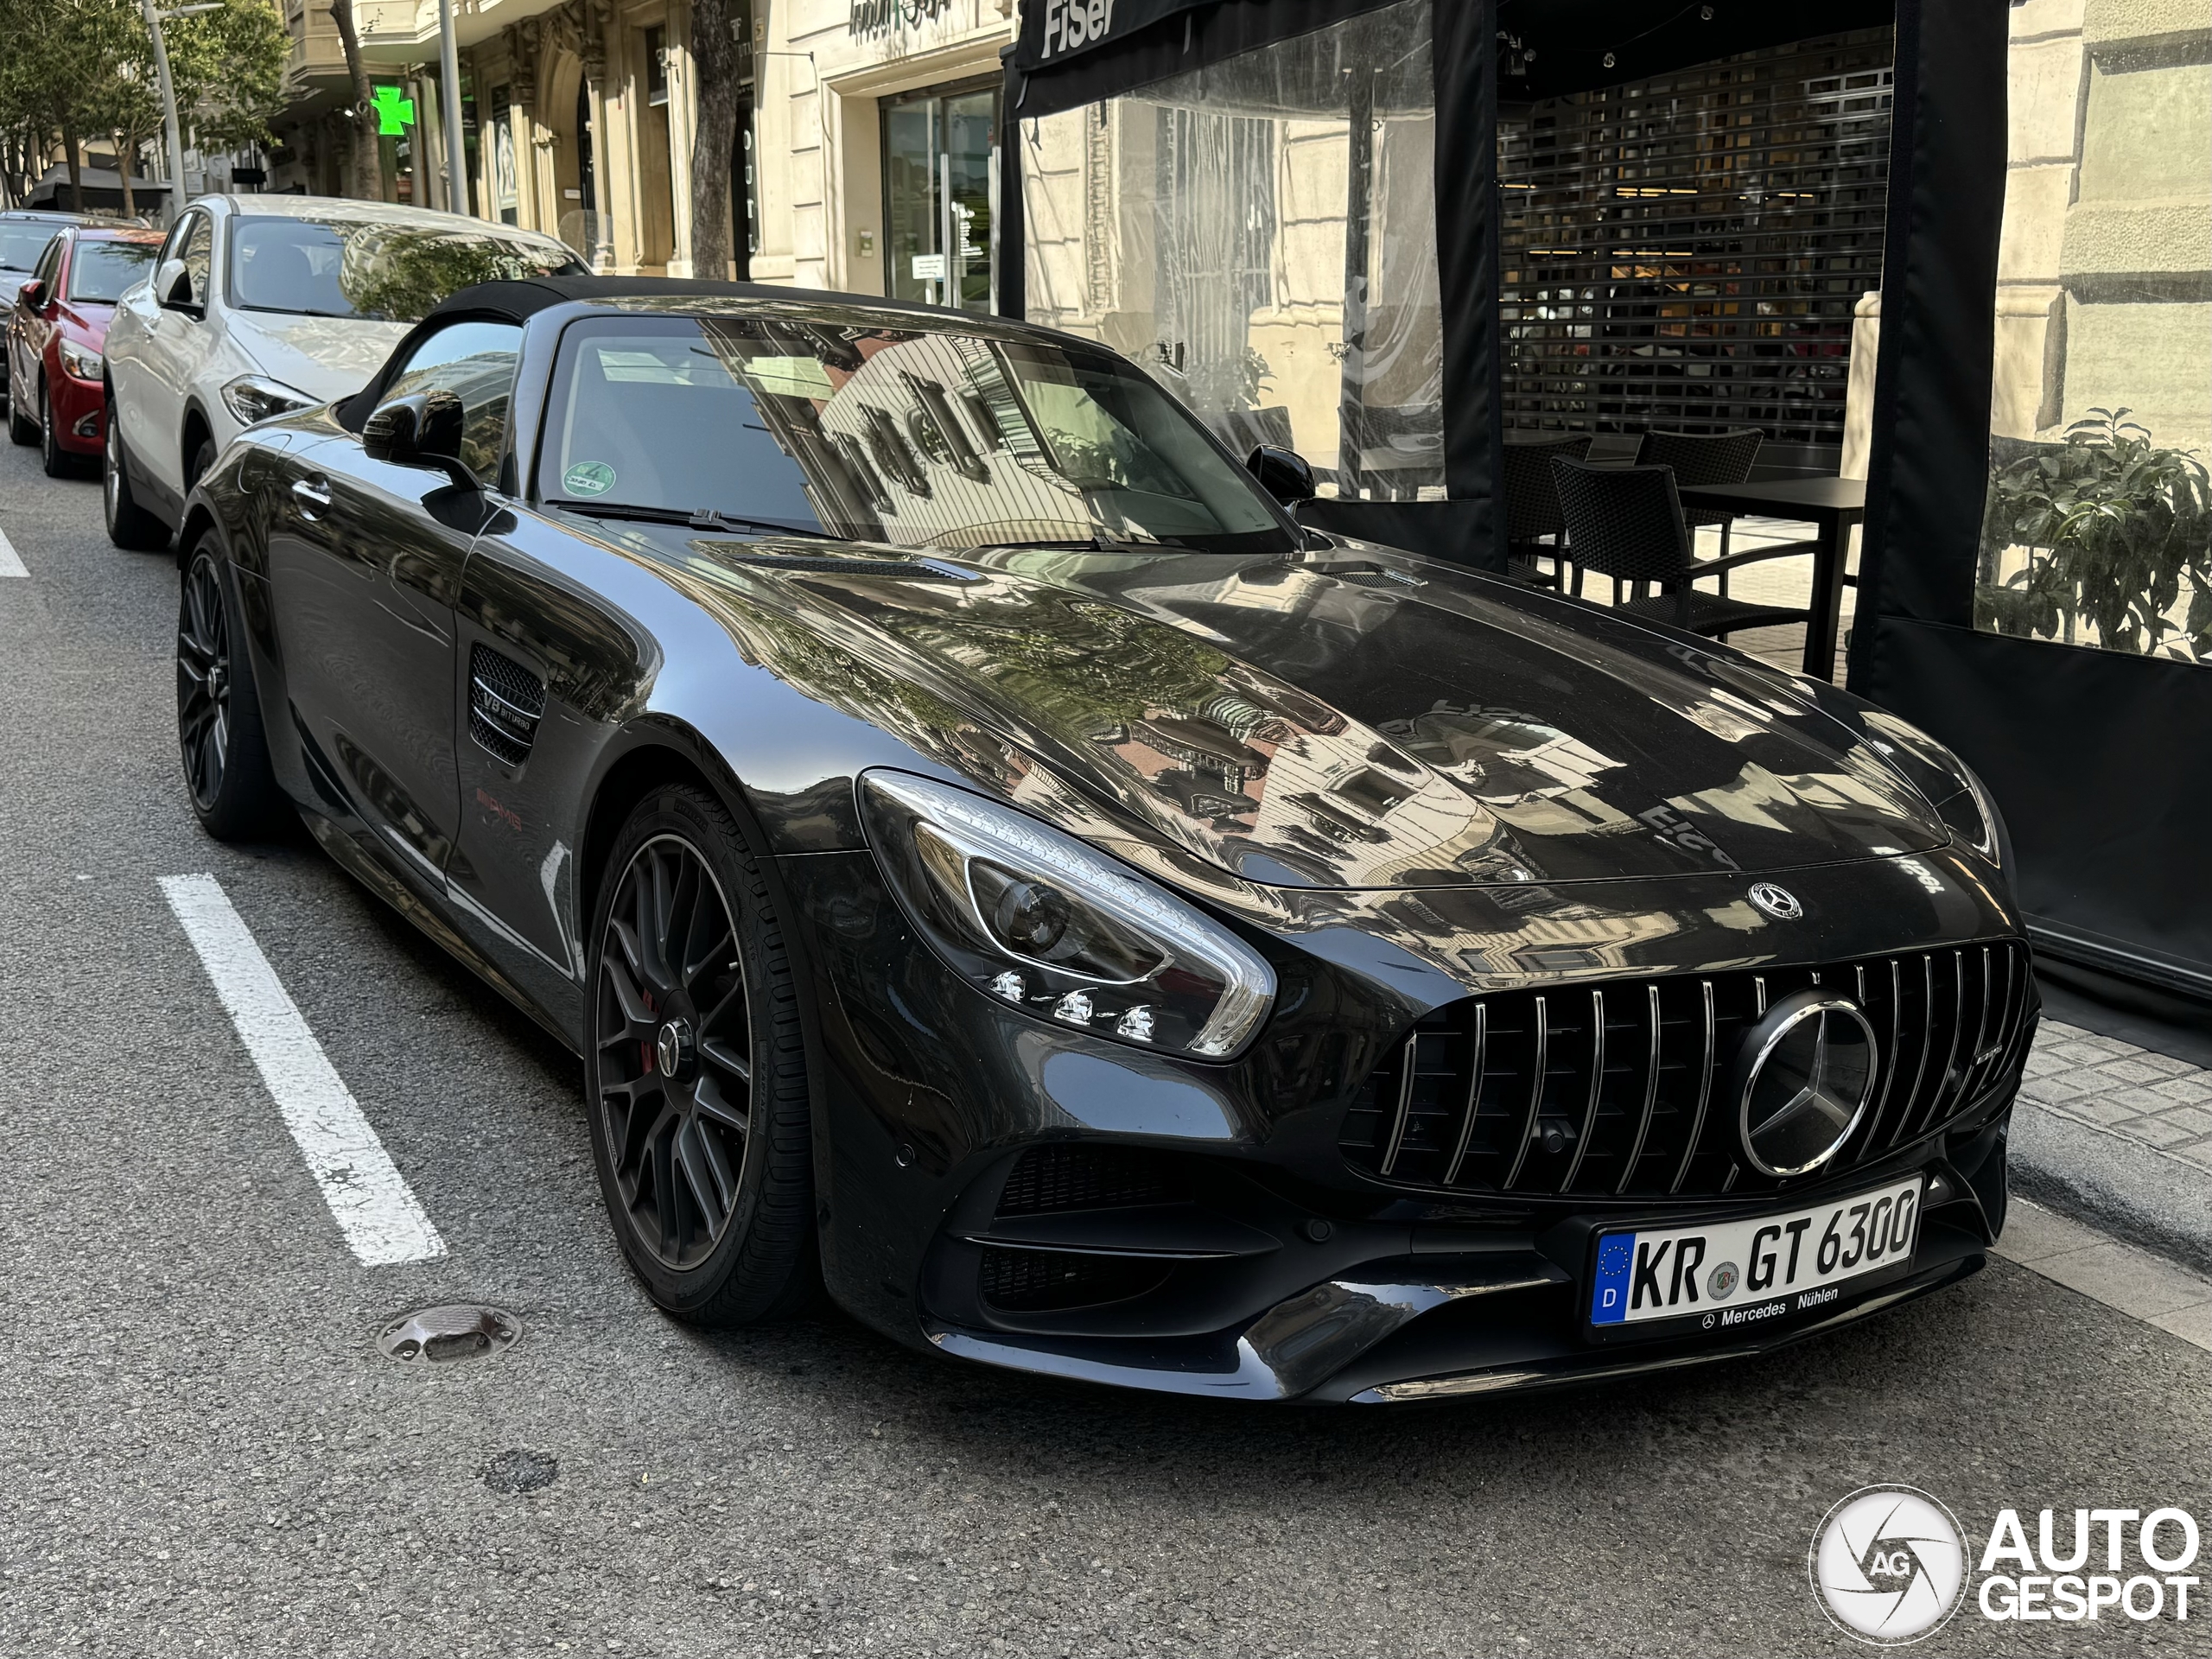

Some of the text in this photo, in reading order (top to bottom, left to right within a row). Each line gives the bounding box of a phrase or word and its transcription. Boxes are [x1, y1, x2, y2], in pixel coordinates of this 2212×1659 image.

[584, 464, 603, 480] 4
[484, 692, 531, 730] V8 BITURBO
[1602, 1287, 1616, 1308] D
[1630, 1236, 1707, 1310] KR
[1745, 1217, 1812, 1293] GT
[1816, 1189, 1916, 1275] 6300
[1721, 1287, 1839, 1327] Mercedes Nühlen
